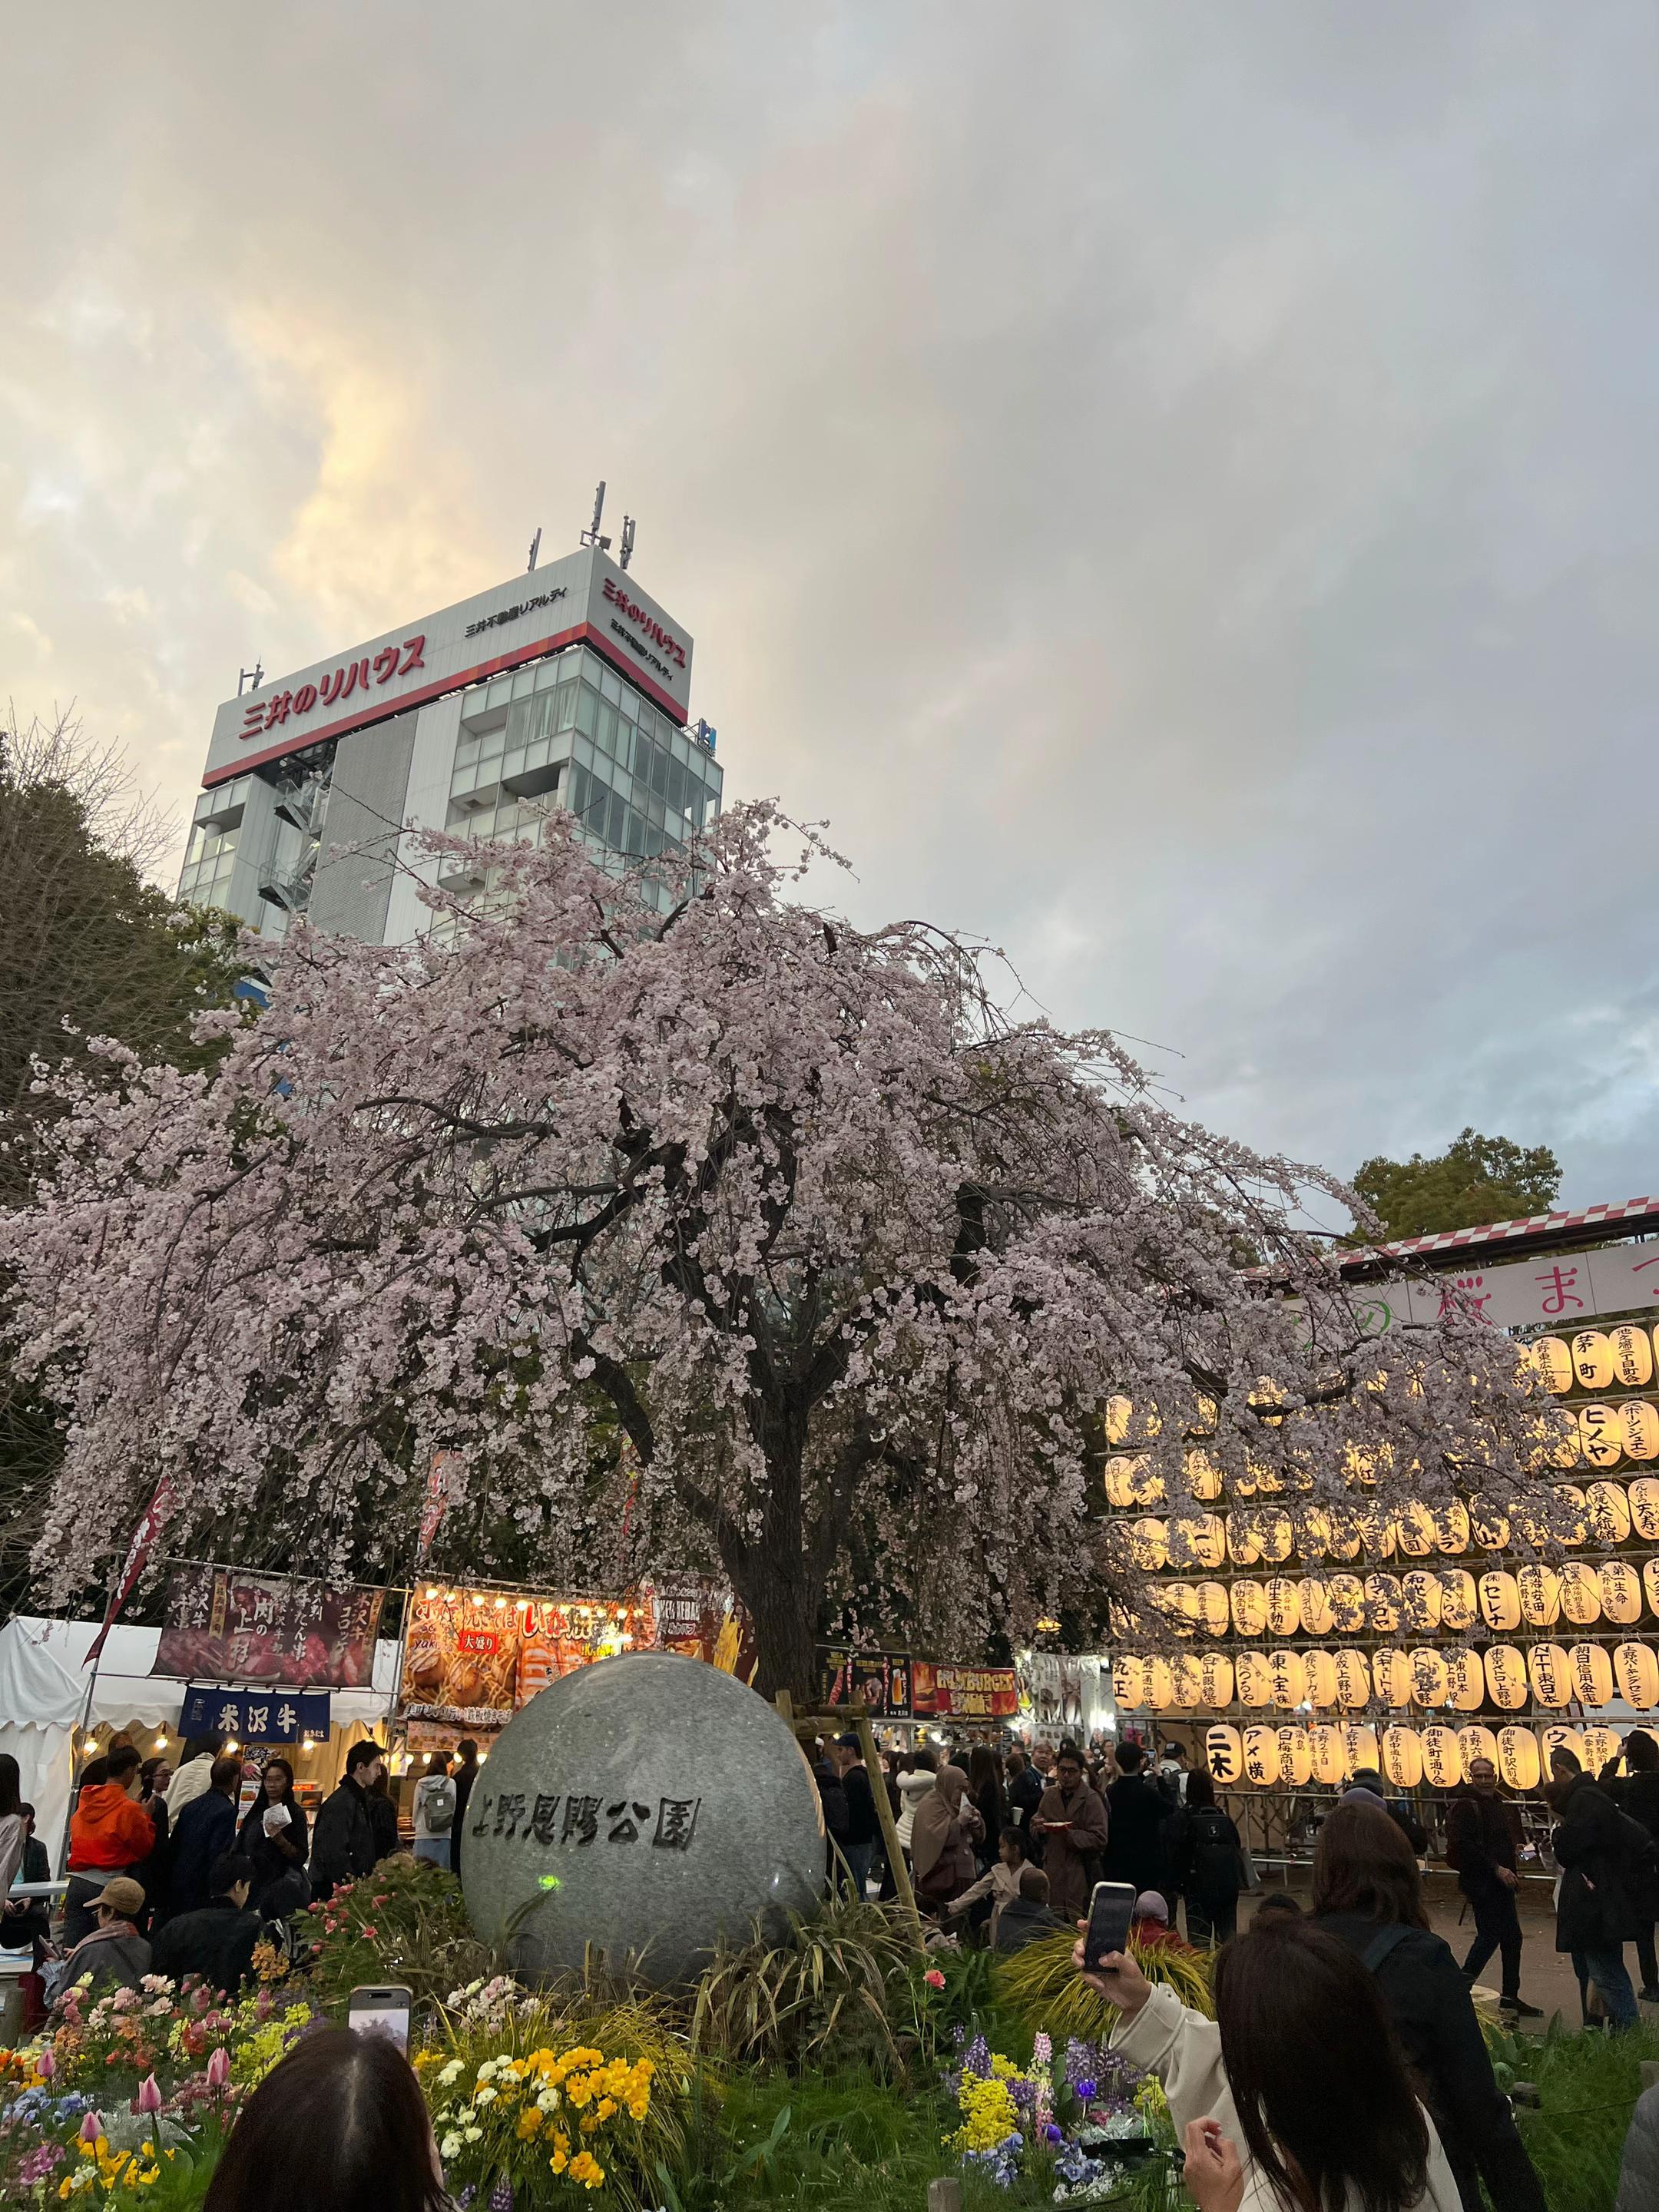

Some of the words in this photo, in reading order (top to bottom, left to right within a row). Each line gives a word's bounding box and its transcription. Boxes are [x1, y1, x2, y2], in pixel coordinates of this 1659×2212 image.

[465, 587, 568, 637] 三井不動産リアルティ
[602, 578, 686, 668] 三井のリハウス
[610, 618, 674, 681] 三井不動産リアルティ
[239, 634, 426, 739] 三井のリハウス
[1577, 1335, 1597, 1379] 茅町
[1586, 1410, 1609, 1461] ヒノヤ
[1520, 1578, 1536, 1620] 上野支社
[1530, 1568, 1545, 1611] 明治安田
[1613, 1566, 1628, 1604] 第一生命
[464, 1634, 492, 1651] 大盛り
[1114, 1659, 1129, 1699] 丸正
[1202, 1657, 1216, 1705] 白山眼鏡店
[1336, 1652, 1354, 1704] 京成上野駅
[1413, 1651, 1432, 1704] アト上野
[1446, 1664, 1459, 1702] 上野駅
[1456, 1651, 1469, 1693] R東日本
[1535, 1647, 1560, 1703] NTT東日本
[1576, 1647, 1598, 1702] 朝日信用金庫
[217, 1704, 296, 1734] 米沢牛
[1208, 1733, 1233, 1778] 二木
[1247, 1730, 1265, 1780] アメ横
[1426, 1729, 1446, 1785] 御徒町通り会
[471, 1793, 702, 1850] 上野恩賜公園
